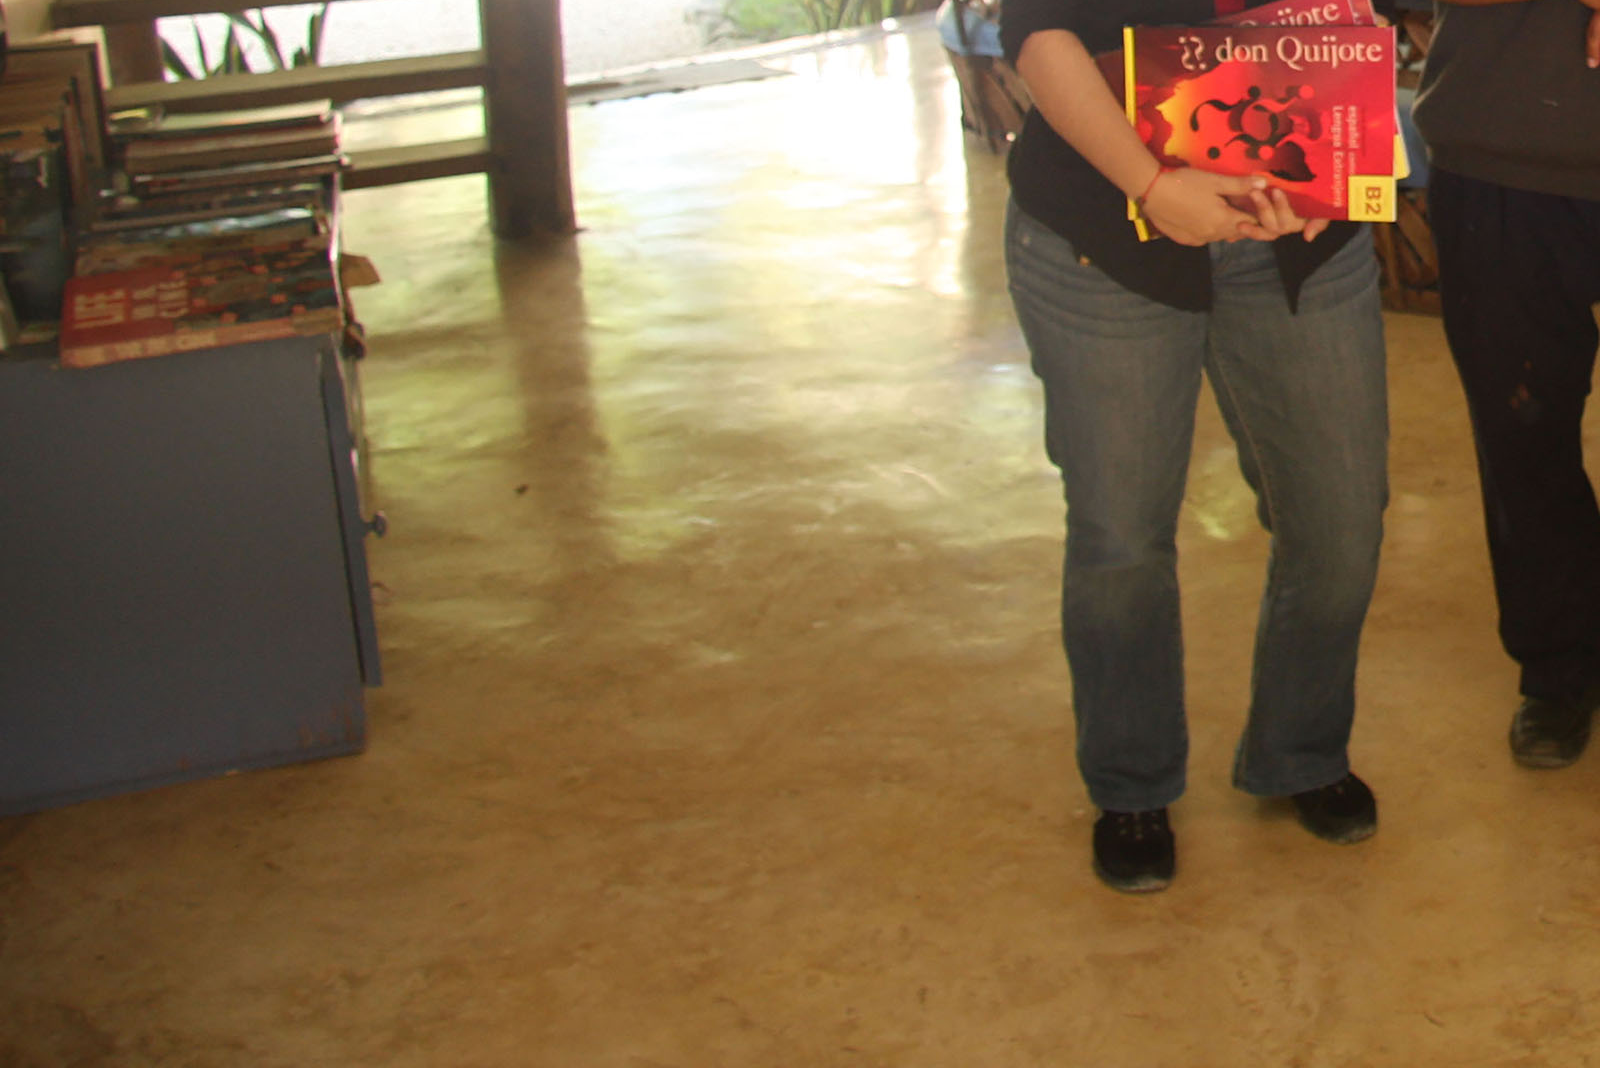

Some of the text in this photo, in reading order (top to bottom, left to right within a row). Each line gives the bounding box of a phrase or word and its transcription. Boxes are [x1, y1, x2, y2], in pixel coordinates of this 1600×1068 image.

[1215, 36, 1269, 63] don
[1276, 35, 1383, 70] Quijote
[1331, 105, 1344, 148] Lengua
[1365, 186, 1381, 215] B2
